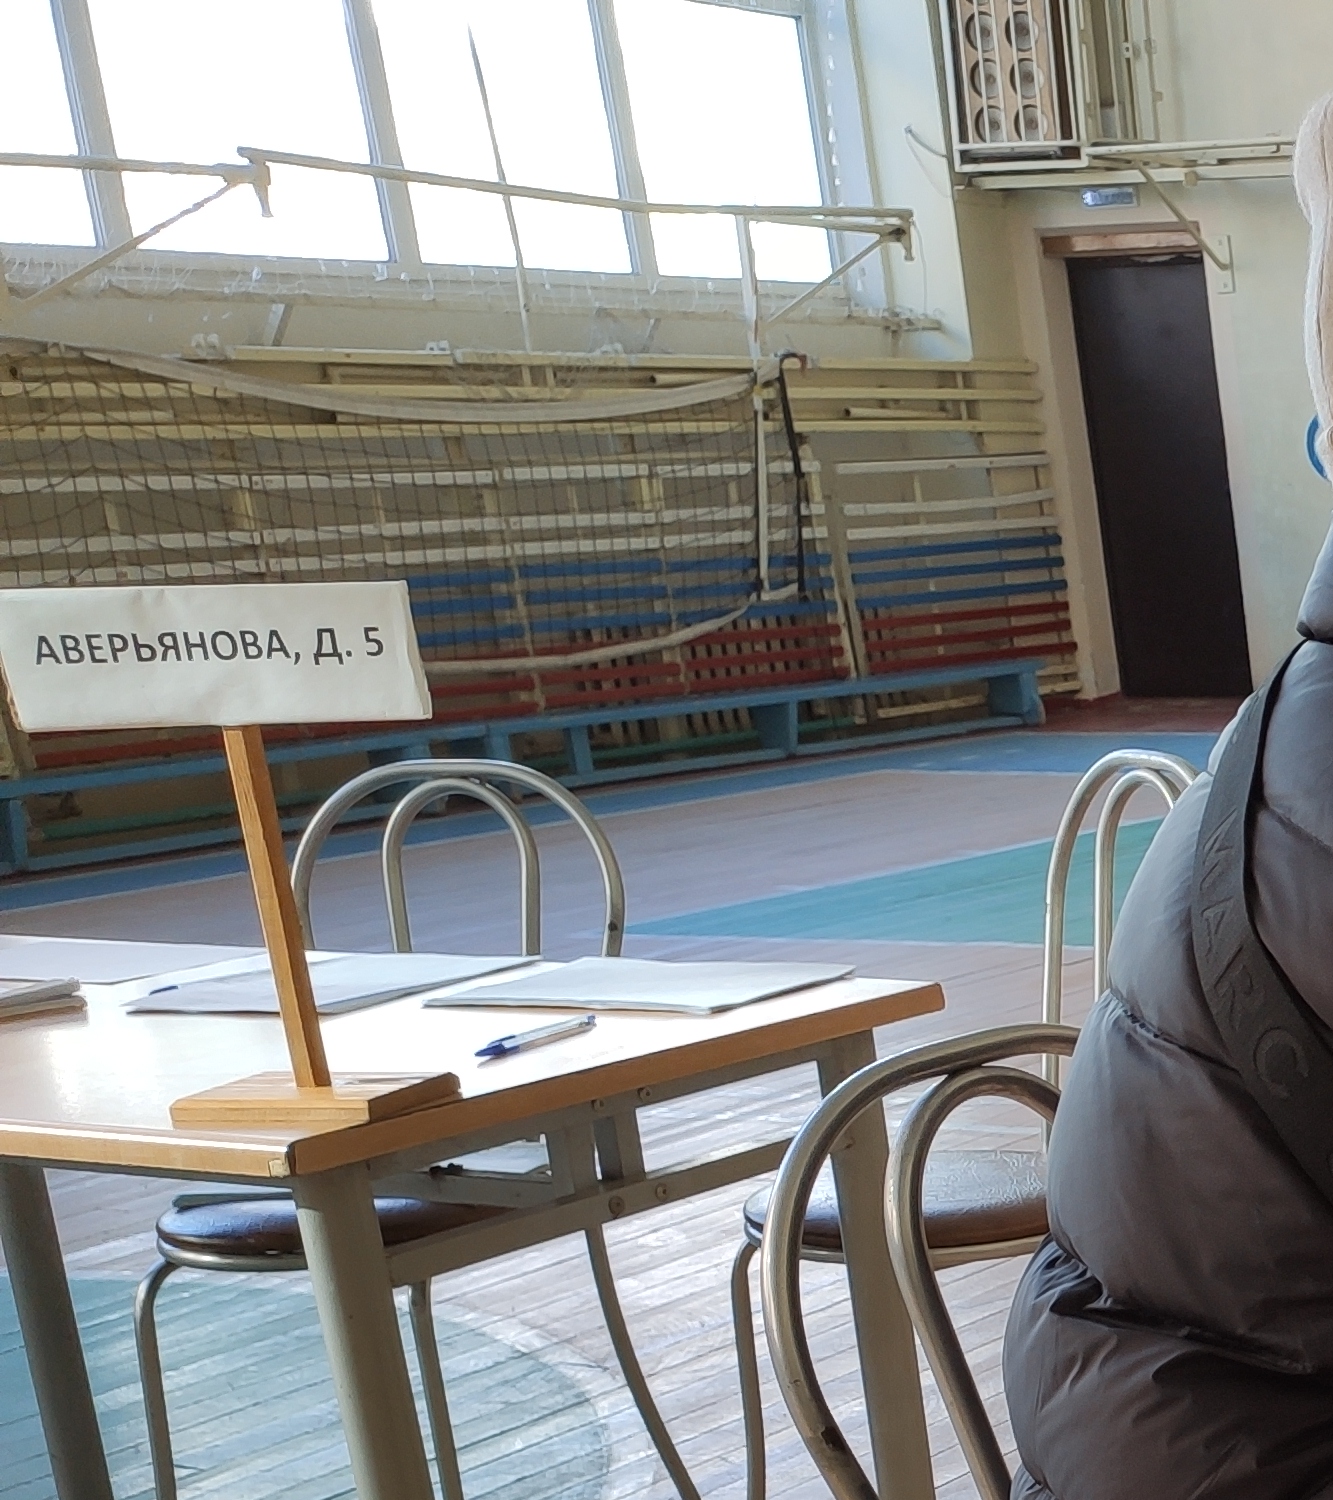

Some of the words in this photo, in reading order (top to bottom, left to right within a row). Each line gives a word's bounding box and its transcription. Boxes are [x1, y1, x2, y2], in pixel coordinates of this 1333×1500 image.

[34, 629, 302, 667] АВЕРЬЯНОВА,
[312, 626, 354, 667] Д.
[363, 626, 385, 658] 5
